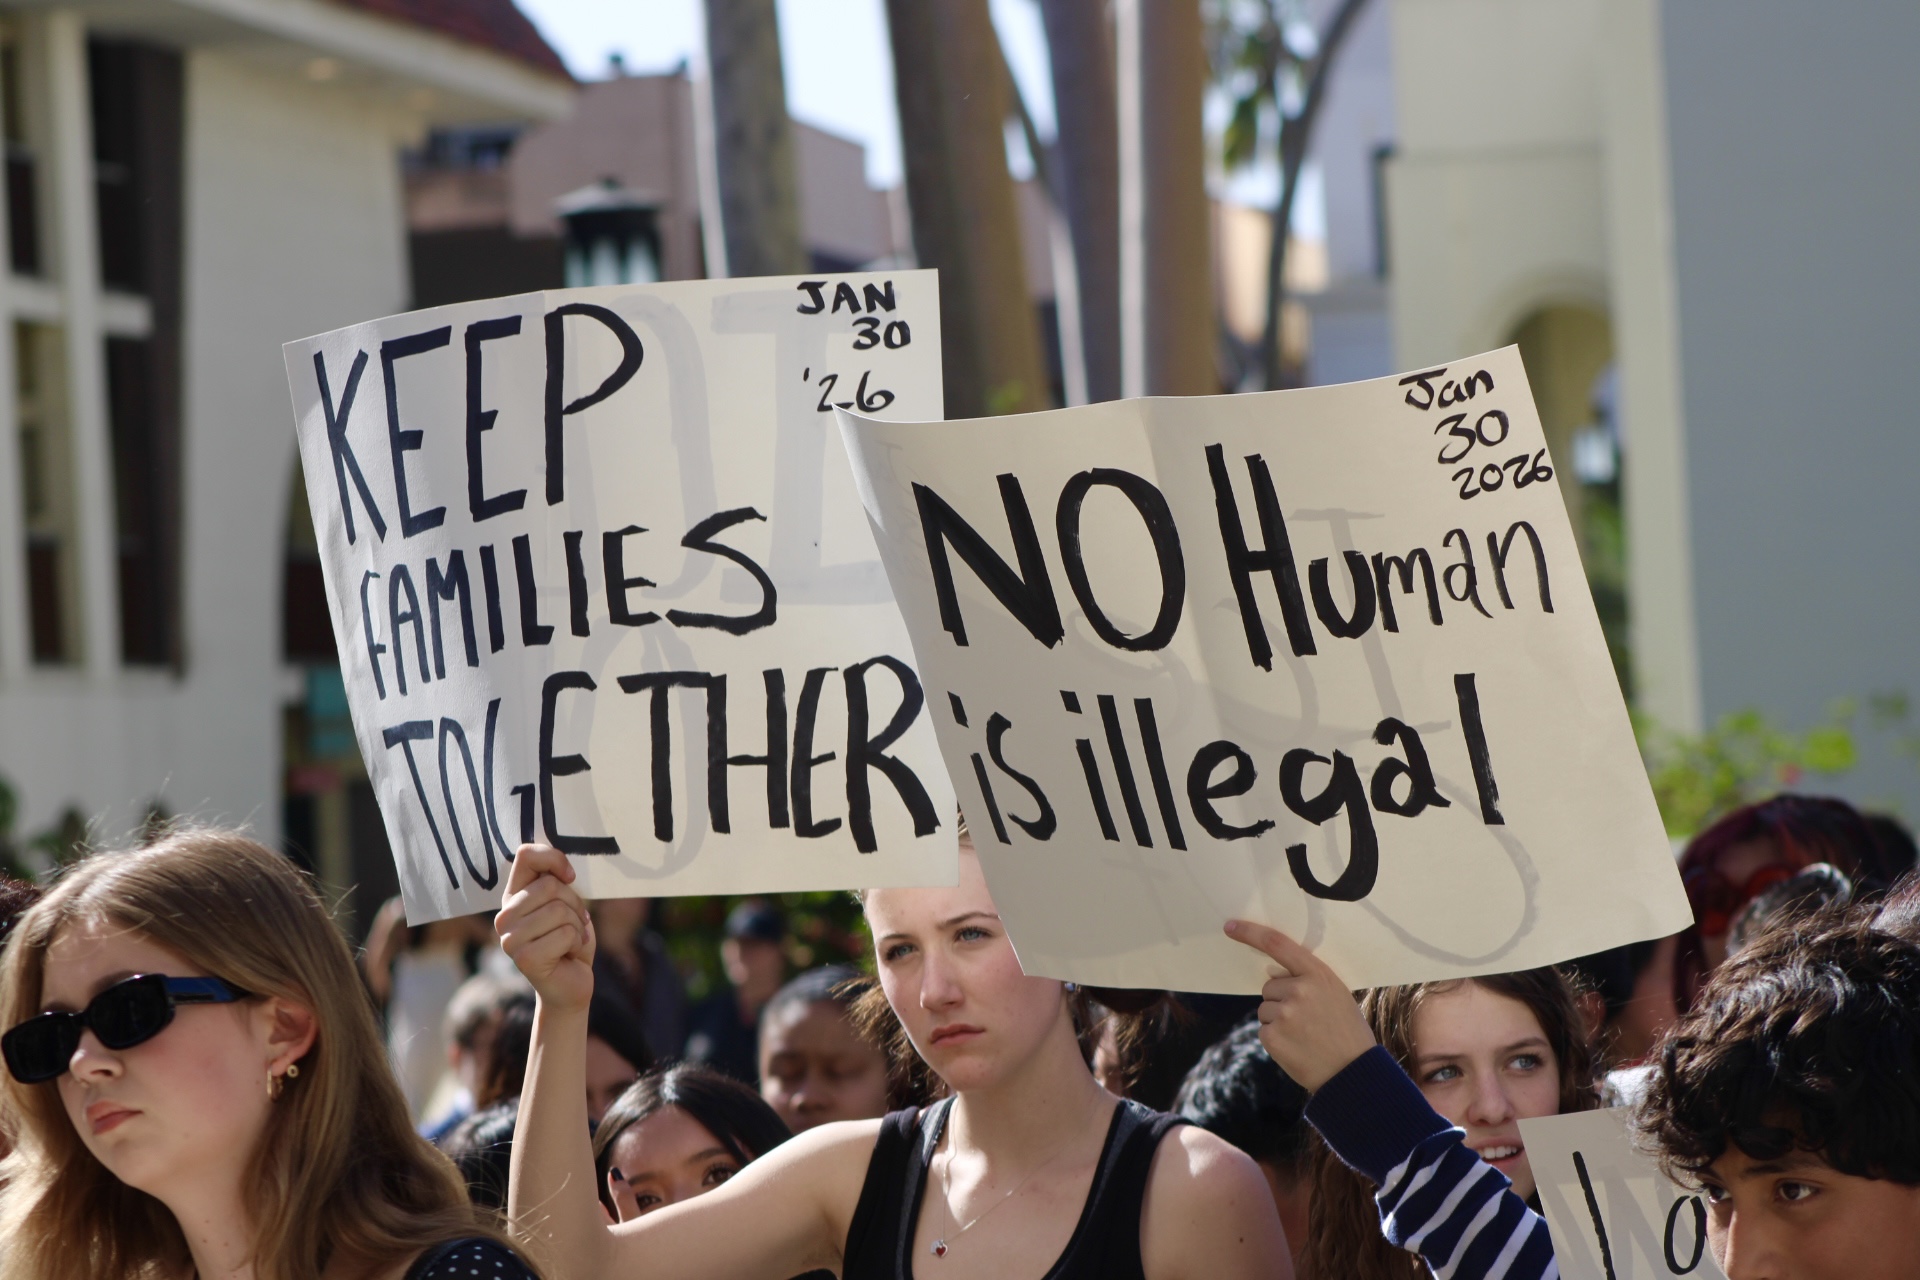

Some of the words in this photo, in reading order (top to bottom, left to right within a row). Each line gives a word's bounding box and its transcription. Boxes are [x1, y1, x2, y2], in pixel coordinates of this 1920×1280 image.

[796, 281, 897, 315] JAN
[852, 316, 911, 351] 30
[313, 302, 644, 546] KEEP
[1398, 367, 1495, 411] Jan
[1435, 409, 1509, 464] 30
[1451, 448, 1554, 501] 2026
[359, 506, 778, 701] FAMILIES
[910, 467, 1186, 651] NO
[1204, 442, 1555, 673] Human
[381, 655, 942, 891] TOGETHER
[946, 690, 1057, 846] is
[1059, 672, 1506, 902] illegal
